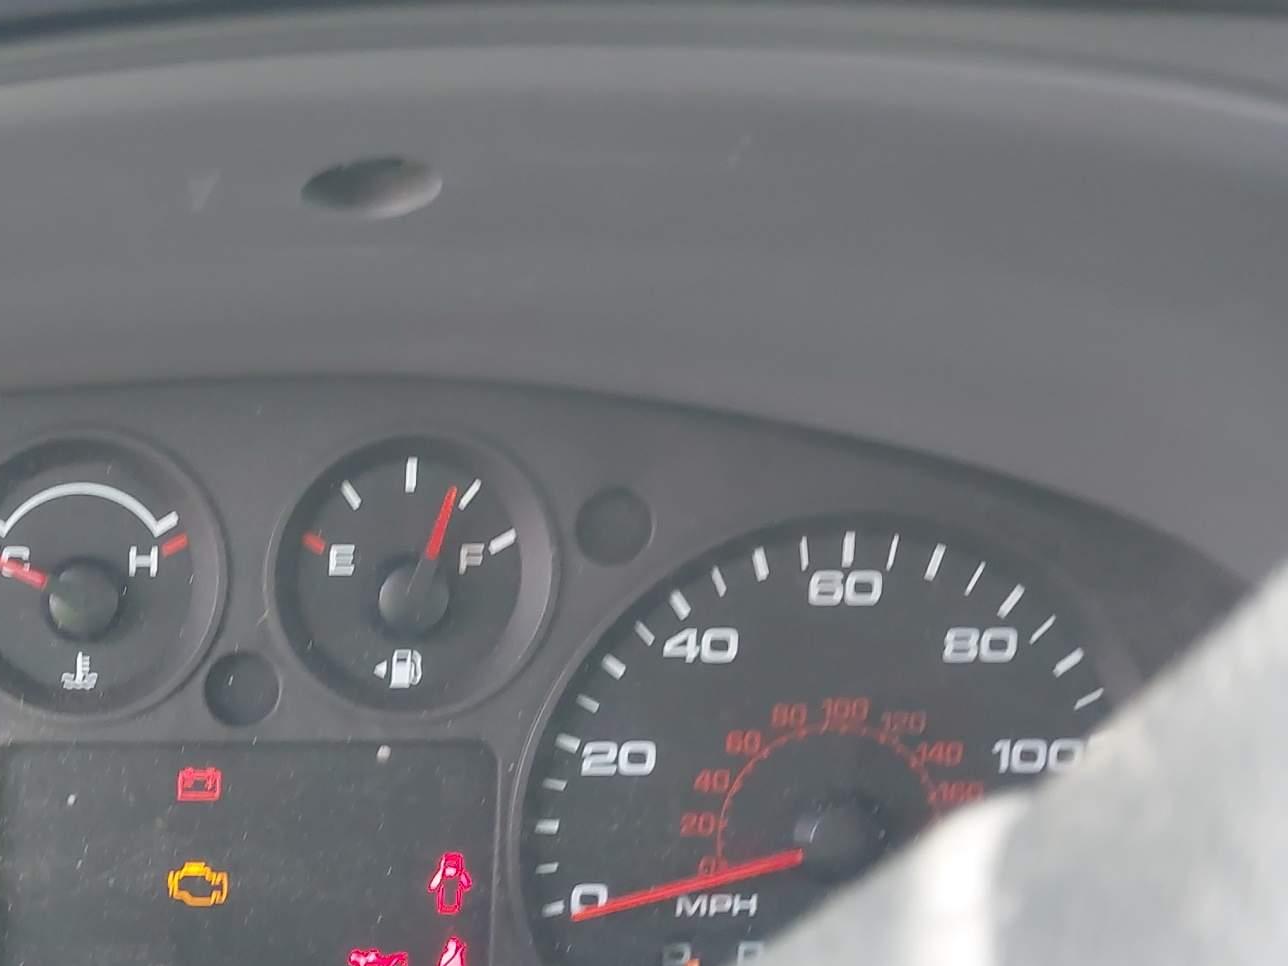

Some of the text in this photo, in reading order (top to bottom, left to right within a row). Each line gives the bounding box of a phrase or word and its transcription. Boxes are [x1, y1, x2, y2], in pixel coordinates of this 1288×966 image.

[129, 546, 160, 577] H
[328, 545, 357, 576] E
[458, 543, 485, 575] F
[807, 569, 883, 607] 60
[662, 627, 739, 664] 40
[942, 627, 1018, 664] 80
[771, 703, 807, 728] 80
[822, 697, 871, 721] 100
[881, 711, 926, 733] 120
[580, 740, 656, 776] 20
[725, 731, 762, 754] 60
[917, 742, 964, 765] 140
[991, 738, 1086, 774] 100
[694, 770, 730, 792] 40
[680, 814, 714, 836] 20
[570, 883, 609, 919] 0
[674, 894, 758, 917] MPH
